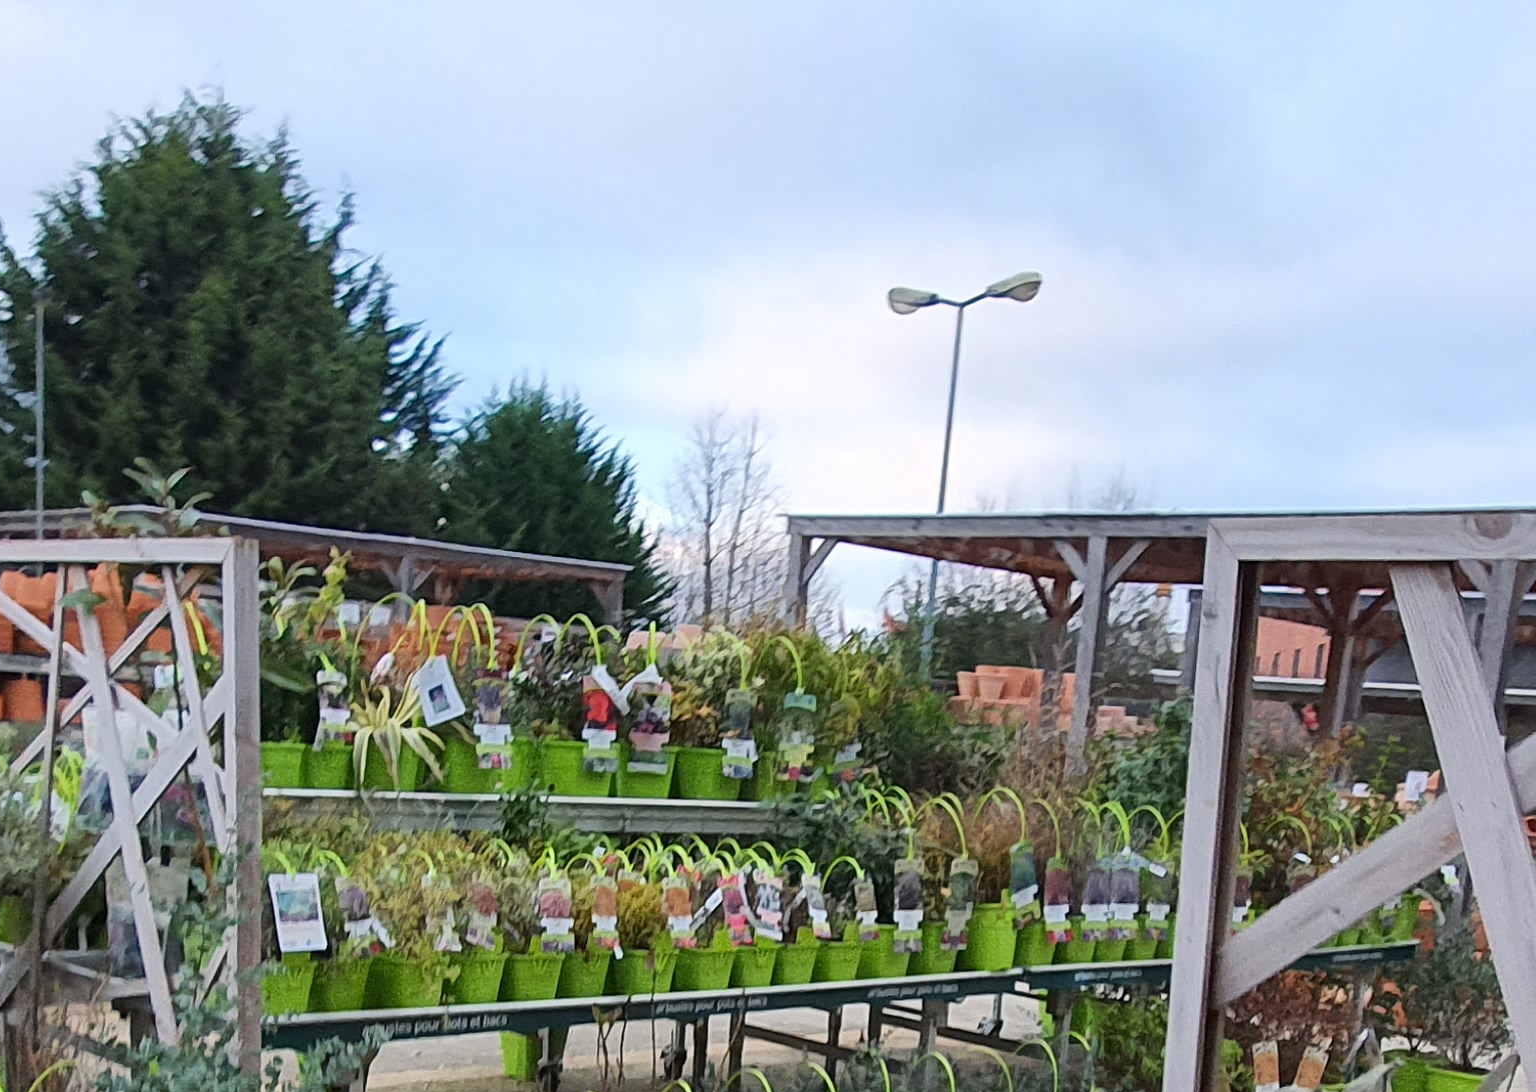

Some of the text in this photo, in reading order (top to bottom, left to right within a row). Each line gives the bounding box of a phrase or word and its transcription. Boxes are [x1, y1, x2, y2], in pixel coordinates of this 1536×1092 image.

[414, 1019, 440, 1036] pour
[442, 1016, 468, 1033] pots
[469, 1014, 481, 1030] et
[482, 1013, 508, 1030] bacs
